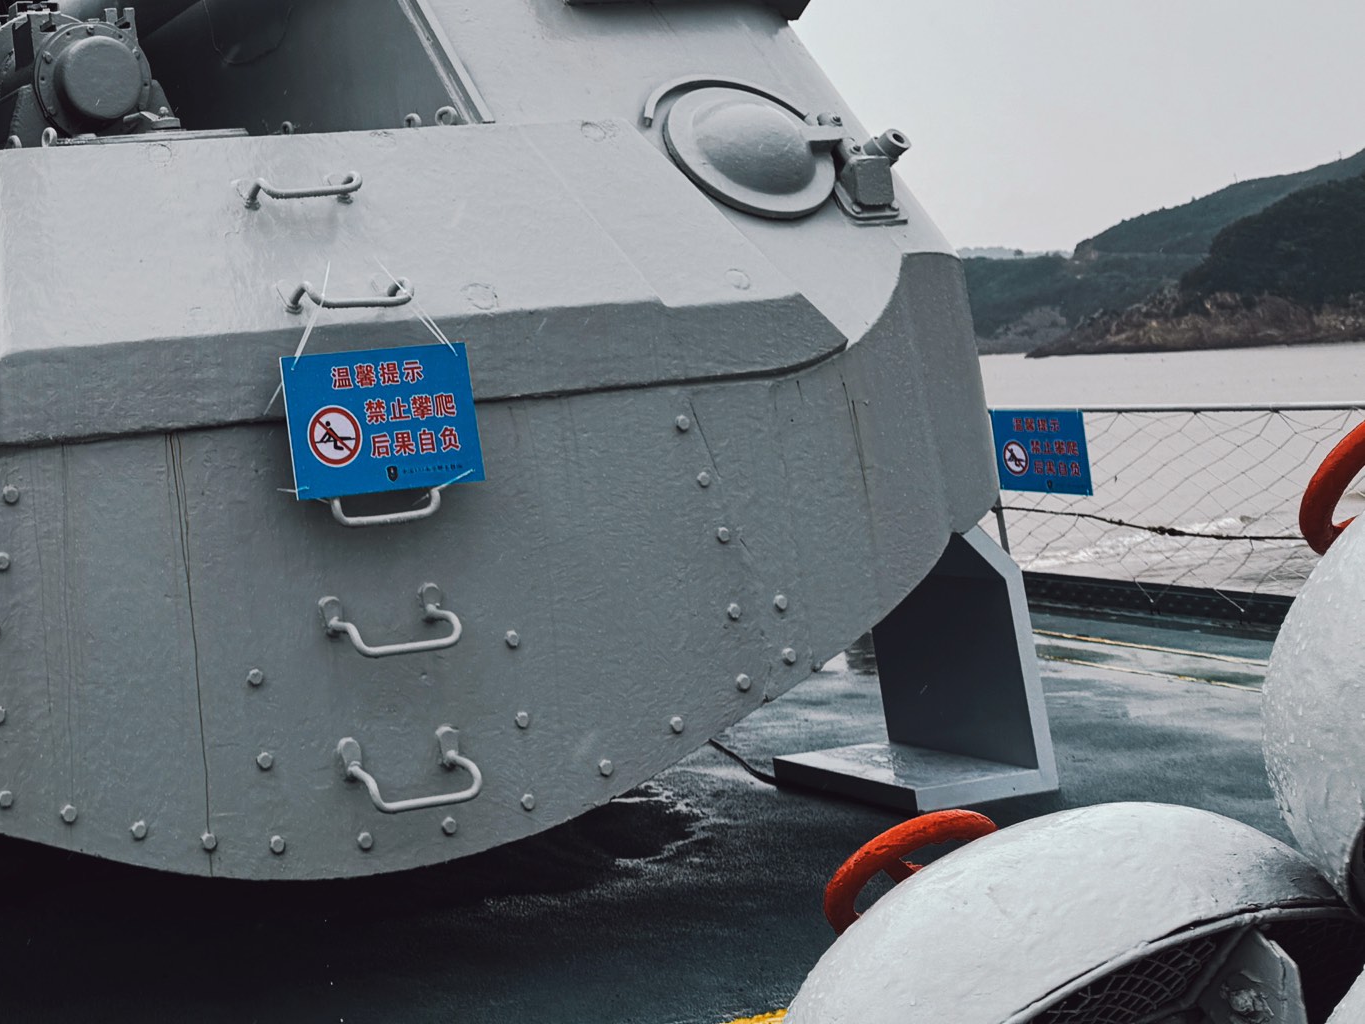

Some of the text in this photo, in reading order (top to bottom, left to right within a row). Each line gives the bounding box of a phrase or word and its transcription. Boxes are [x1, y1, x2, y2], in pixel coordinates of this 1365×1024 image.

[331, 360, 423, 389] 温馨提示
[365, 392, 457, 424] 禁止攀爬
[370, 426, 462, 458] 后果自负
